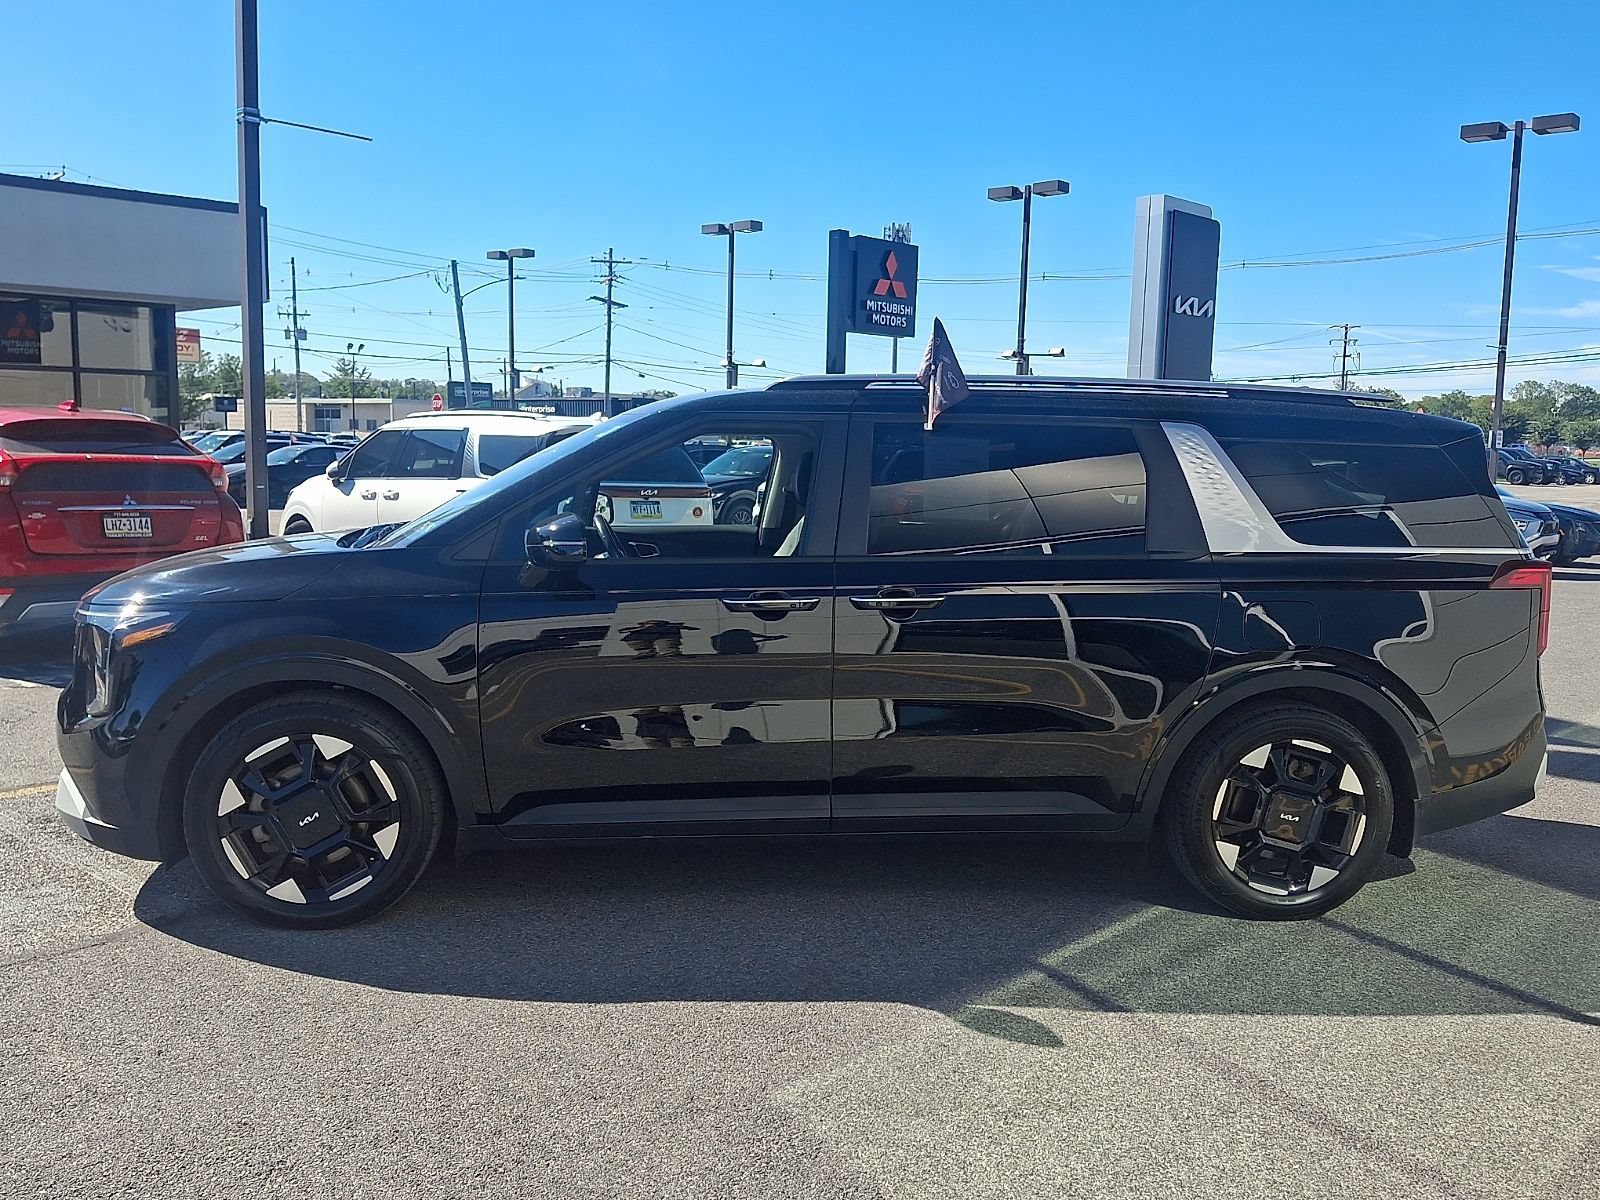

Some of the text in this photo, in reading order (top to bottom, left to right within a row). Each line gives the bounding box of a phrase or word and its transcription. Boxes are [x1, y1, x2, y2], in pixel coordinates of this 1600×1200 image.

[867, 300, 913, 316] MITSUBISHI
[1175, 295, 1213, 318] KIA
[872, 314, 907, 328] MOTORS
[432, 400, 442, 408] STOP
[520, 404, 556, 413] enterprise
[105, 518, 150, 532] LHZ-3144
[299, 812, 319, 826] KIA
[1280, 814, 1299, 822] KIA
